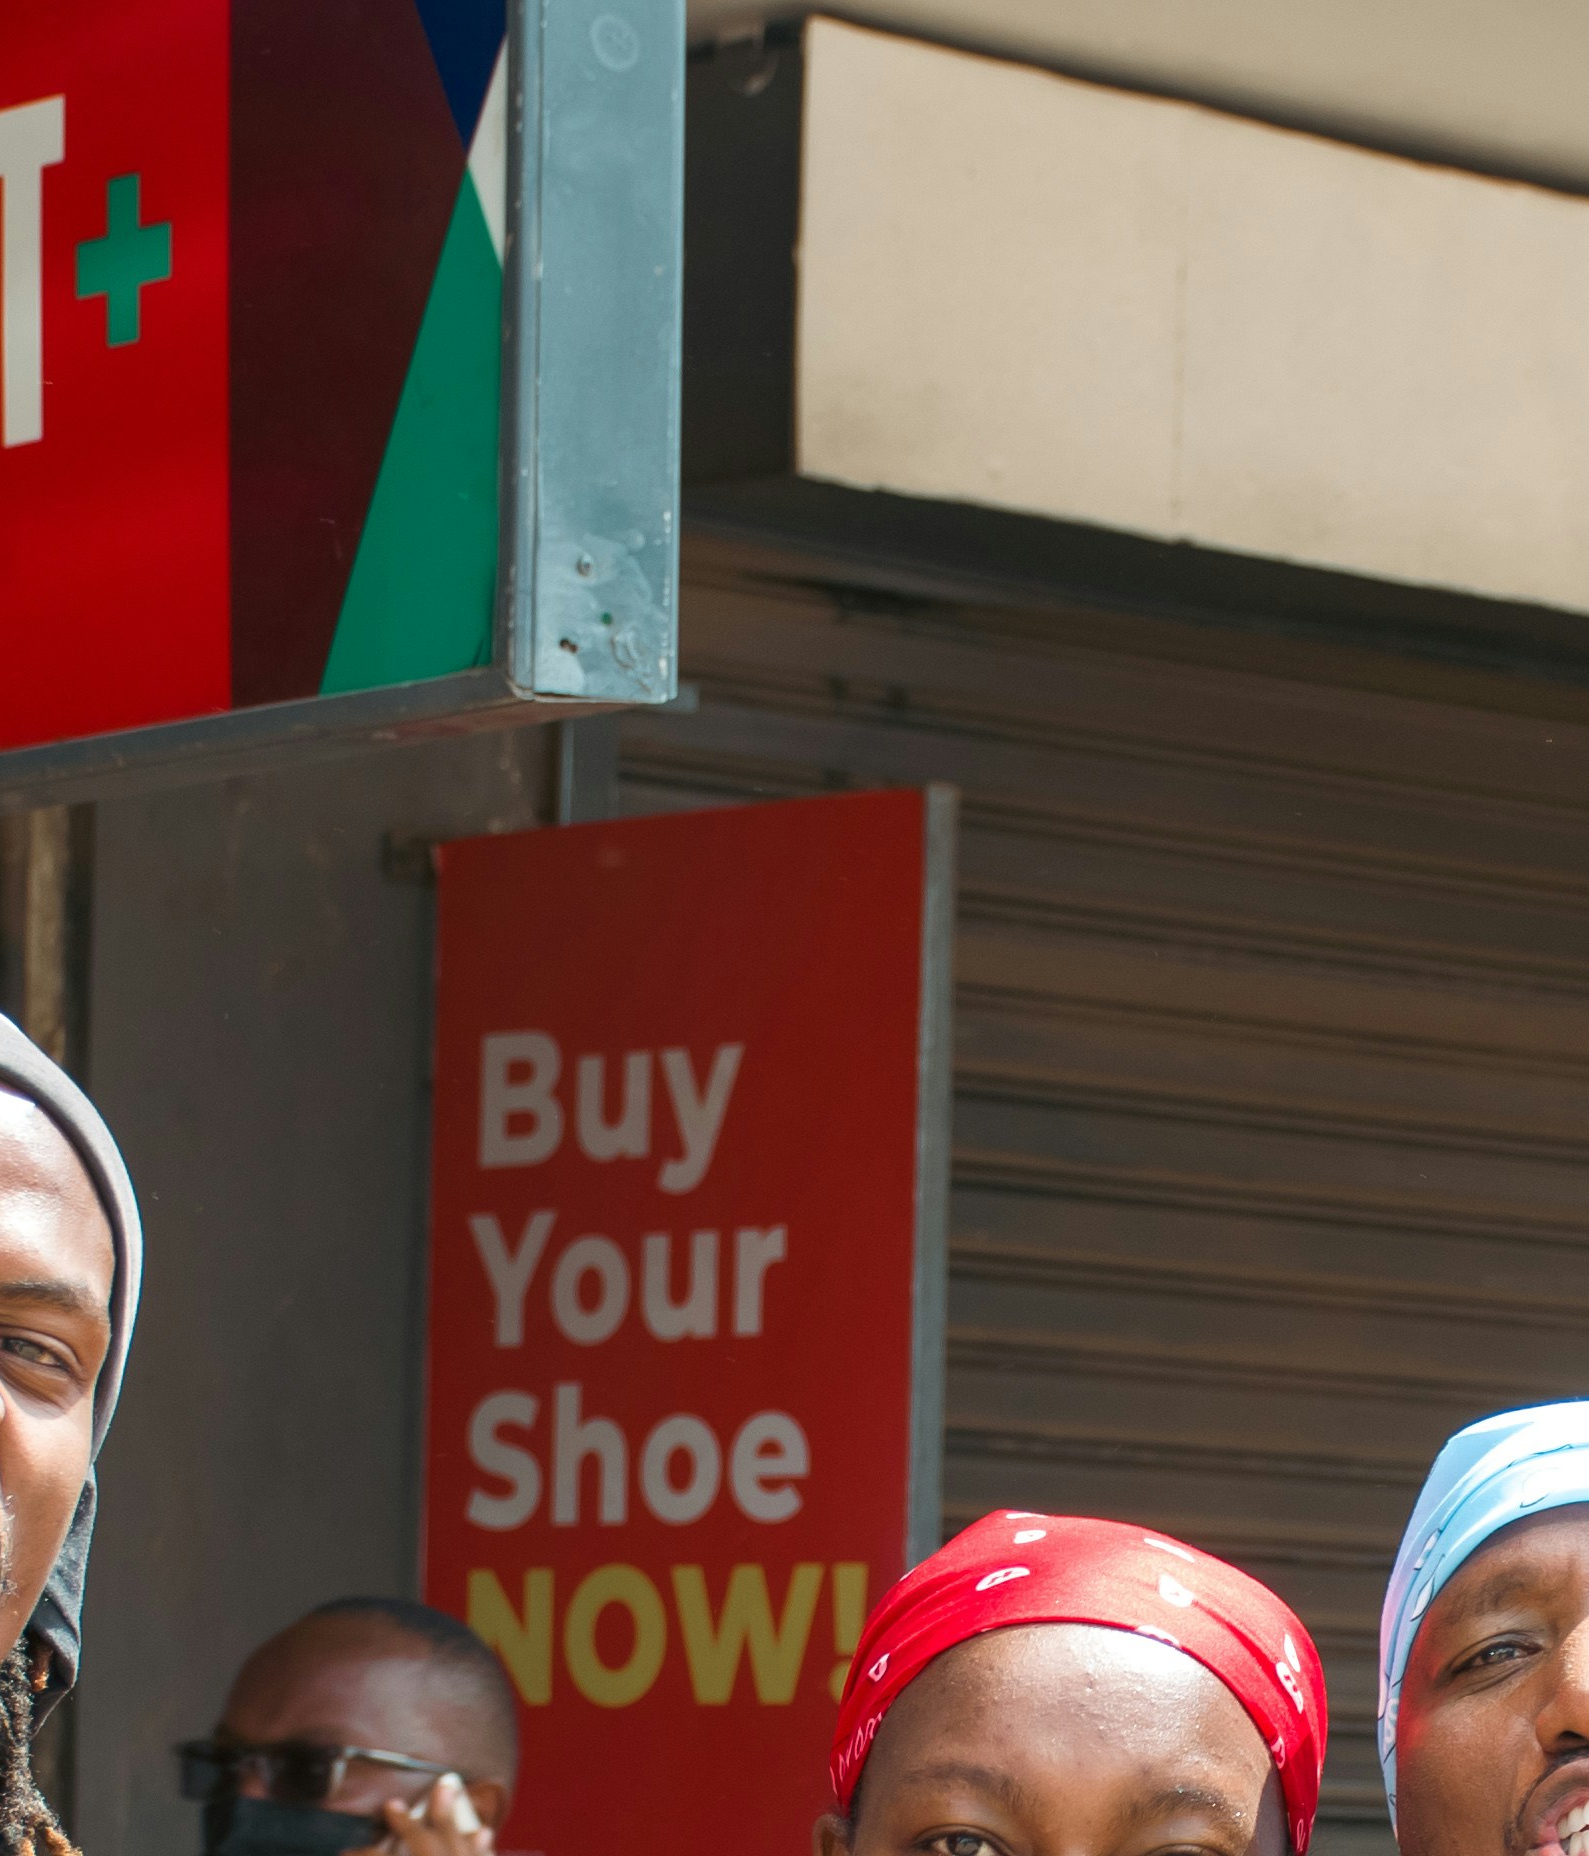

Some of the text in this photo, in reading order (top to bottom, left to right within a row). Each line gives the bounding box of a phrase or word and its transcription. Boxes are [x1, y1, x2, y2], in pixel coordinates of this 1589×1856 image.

[477, 1031, 744, 1194] Buy
[469, 1211, 787, 1347] Your
[465, 1386, 810, 1530] Shoe
[467, 1562, 869, 1706] NOW!
